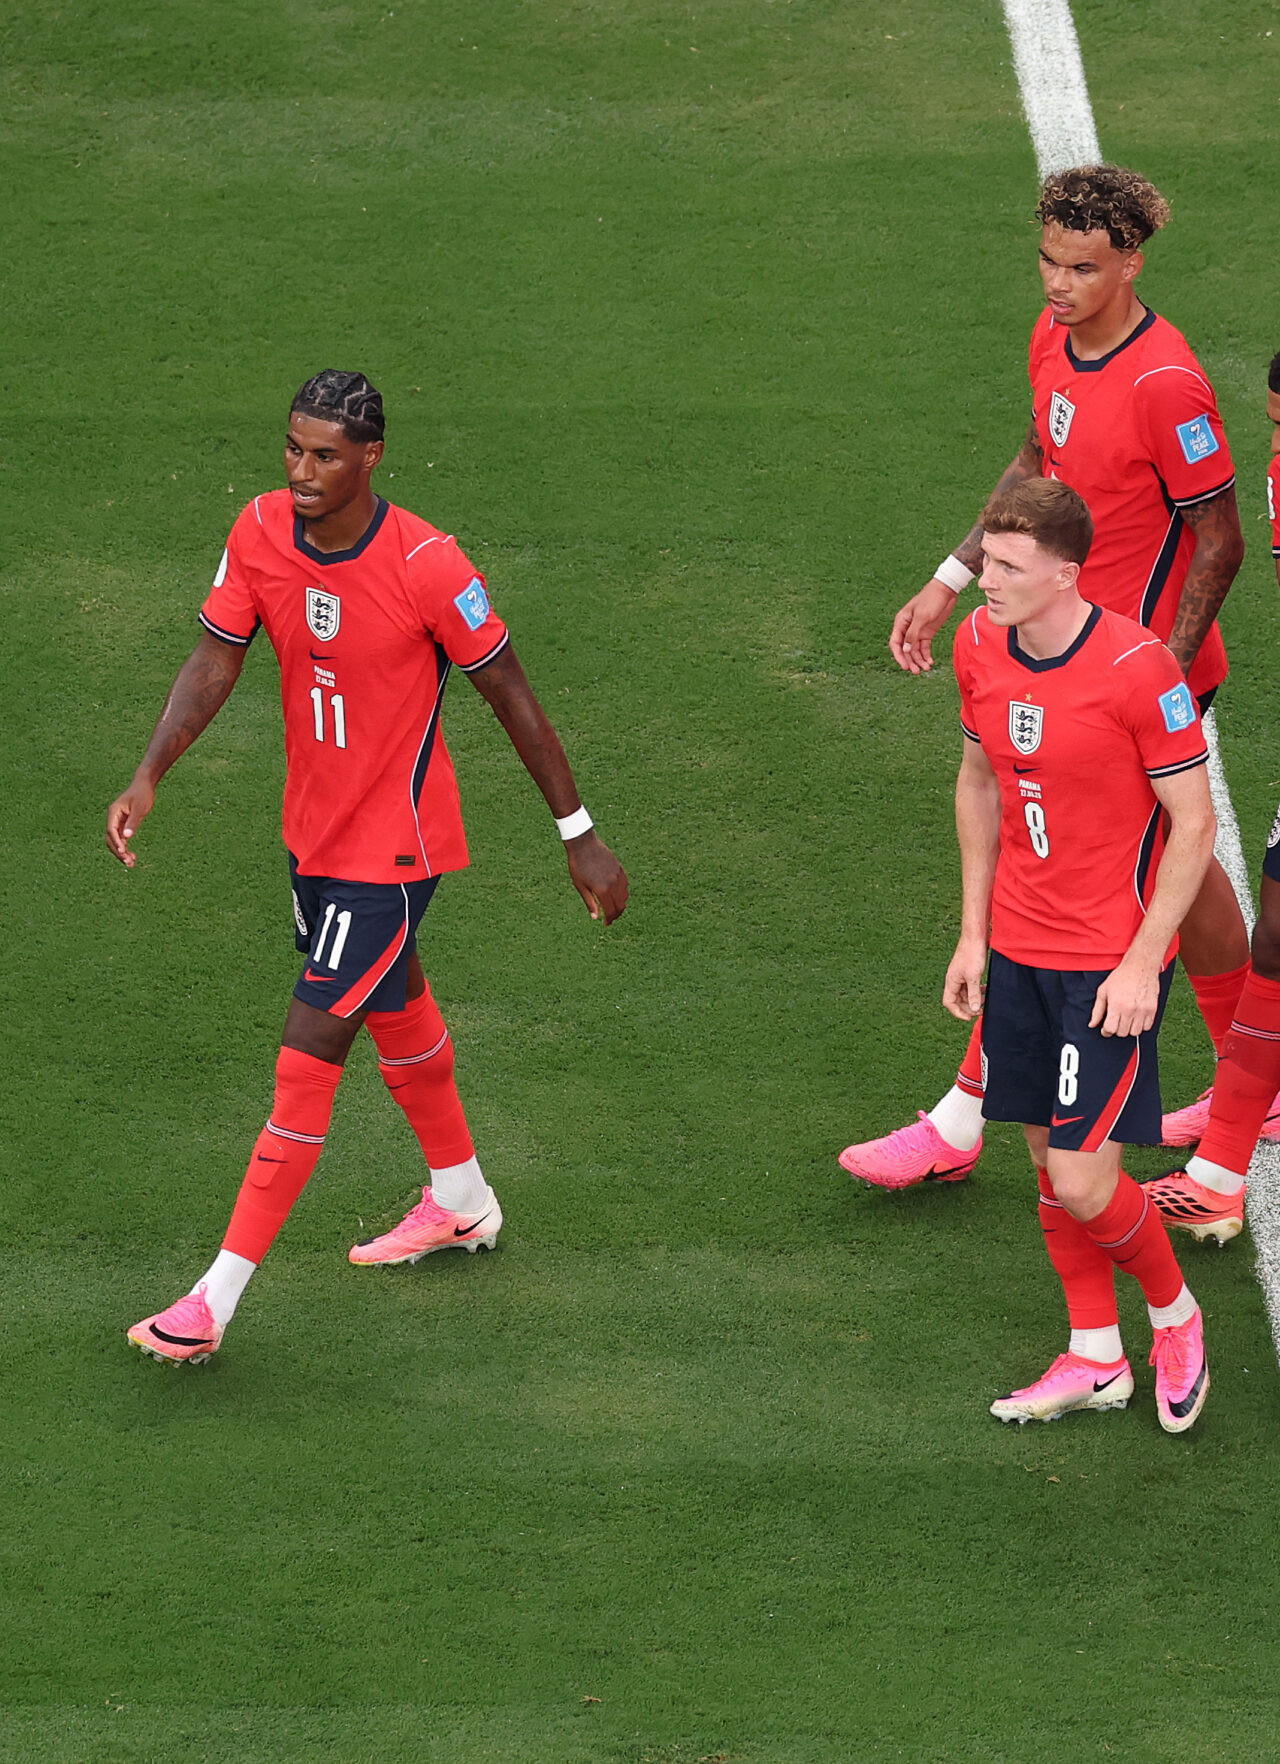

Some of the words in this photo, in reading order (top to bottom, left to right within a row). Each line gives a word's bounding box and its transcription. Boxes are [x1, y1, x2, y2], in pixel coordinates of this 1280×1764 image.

[309, 686, 347, 749] 11
[1024, 801, 1050, 860] 8
[313, 902, 352, 971] 11
[1058, 1043, 1080, 1107] 8
